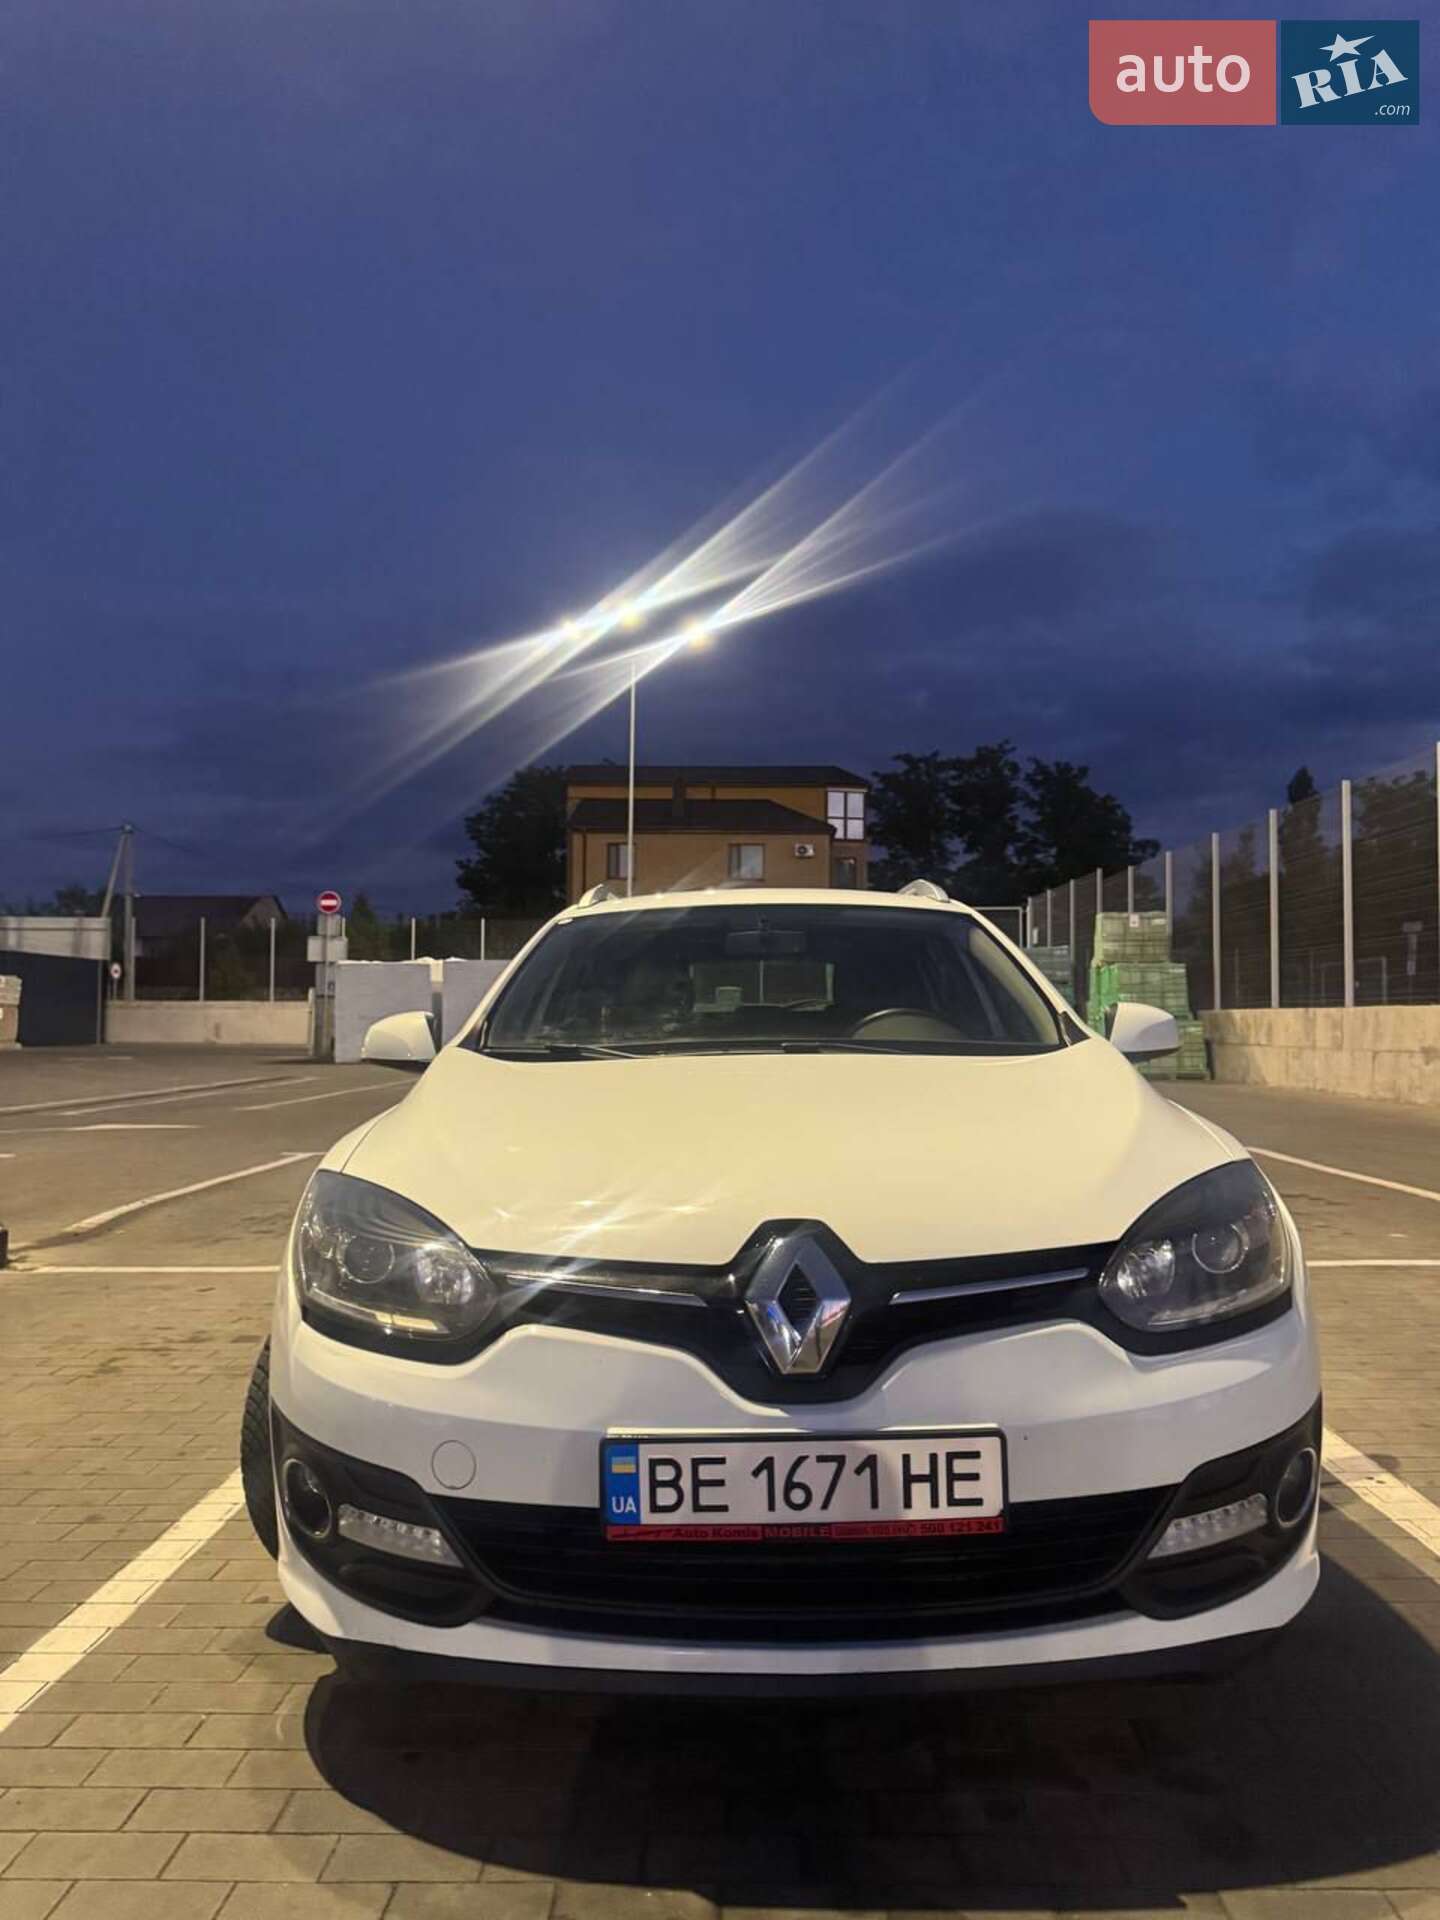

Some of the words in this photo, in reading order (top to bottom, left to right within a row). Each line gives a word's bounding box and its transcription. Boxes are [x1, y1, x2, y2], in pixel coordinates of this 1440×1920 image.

[648, 1457, 729, 1513] BE
[751, 1453, 879, 1512] 1671
[902, 1450, 984, 1509] HE
[612, 1496, 637, 1513] UA
[672, 1526, 708, 1538] Auto
